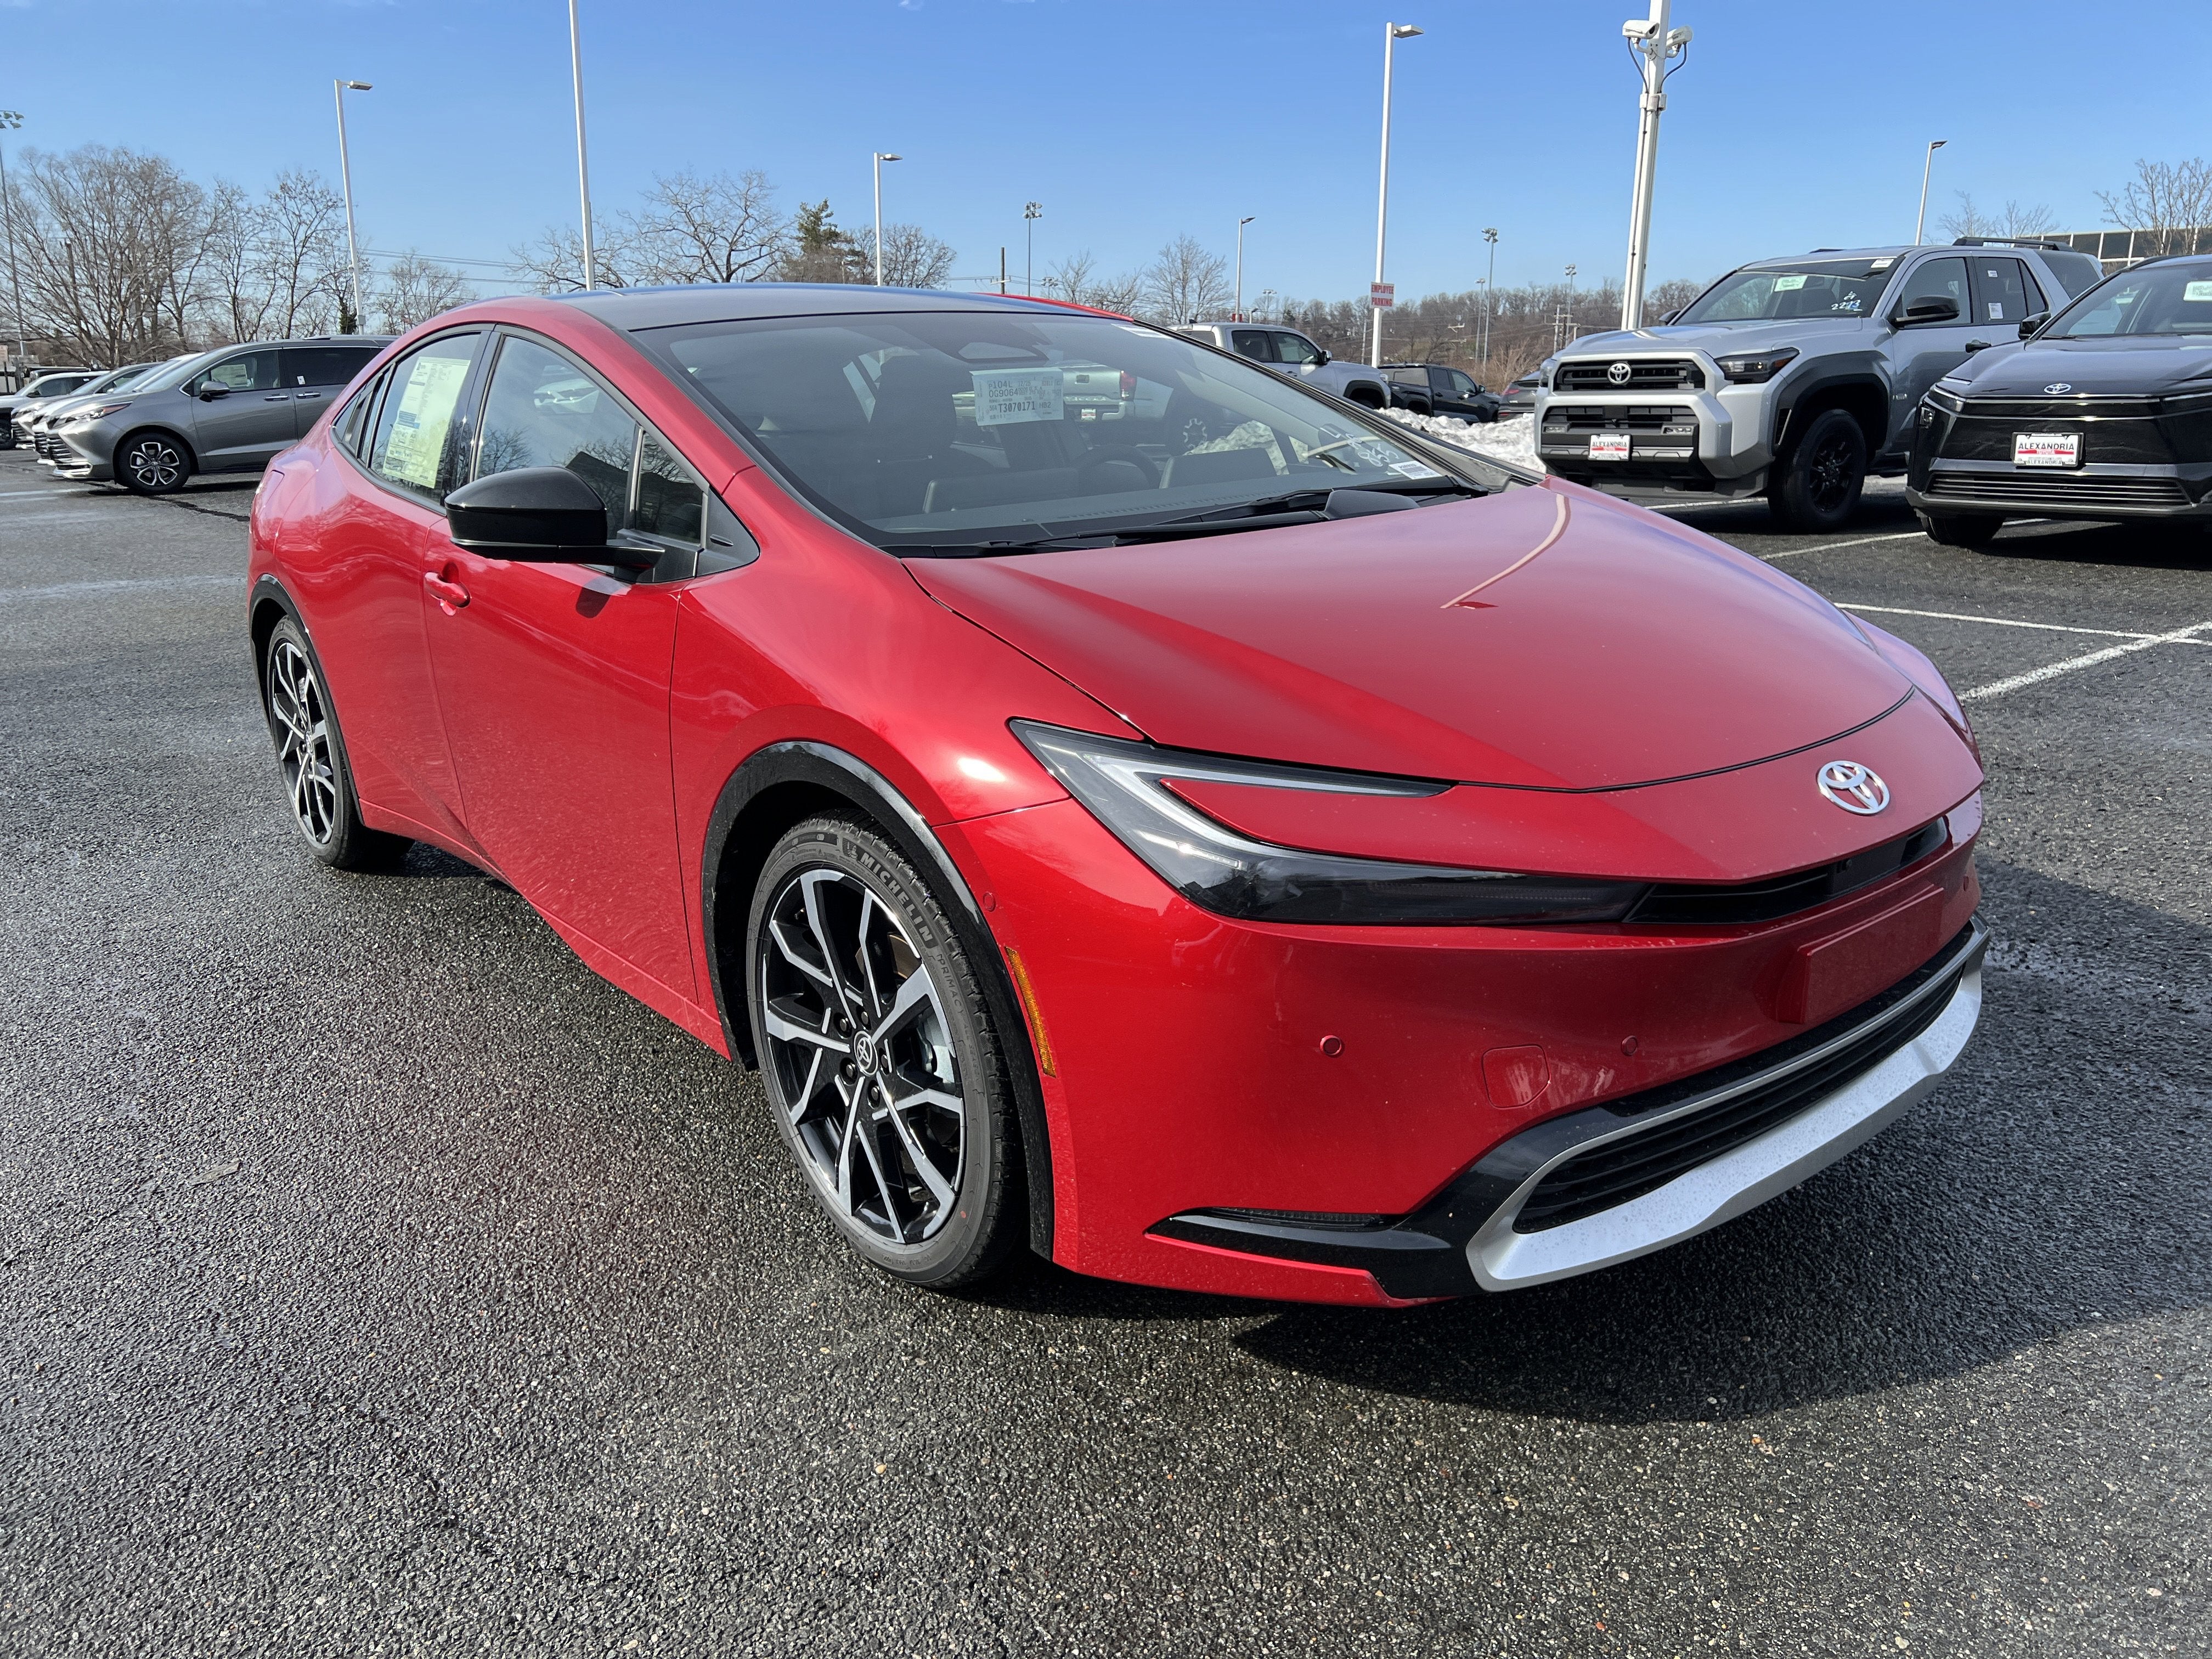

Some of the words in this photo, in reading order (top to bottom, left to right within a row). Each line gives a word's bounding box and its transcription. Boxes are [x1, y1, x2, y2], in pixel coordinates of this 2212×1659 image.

[1372, 284, 1394, 294] EMPLOYEE
[1372, 297, 1392, 307] PARKING
[998, 401, 1036, 413] T3070171
[860, 852, 933, 941] MICHELIN
[938, 958, 964, 1016] PRIMACY
